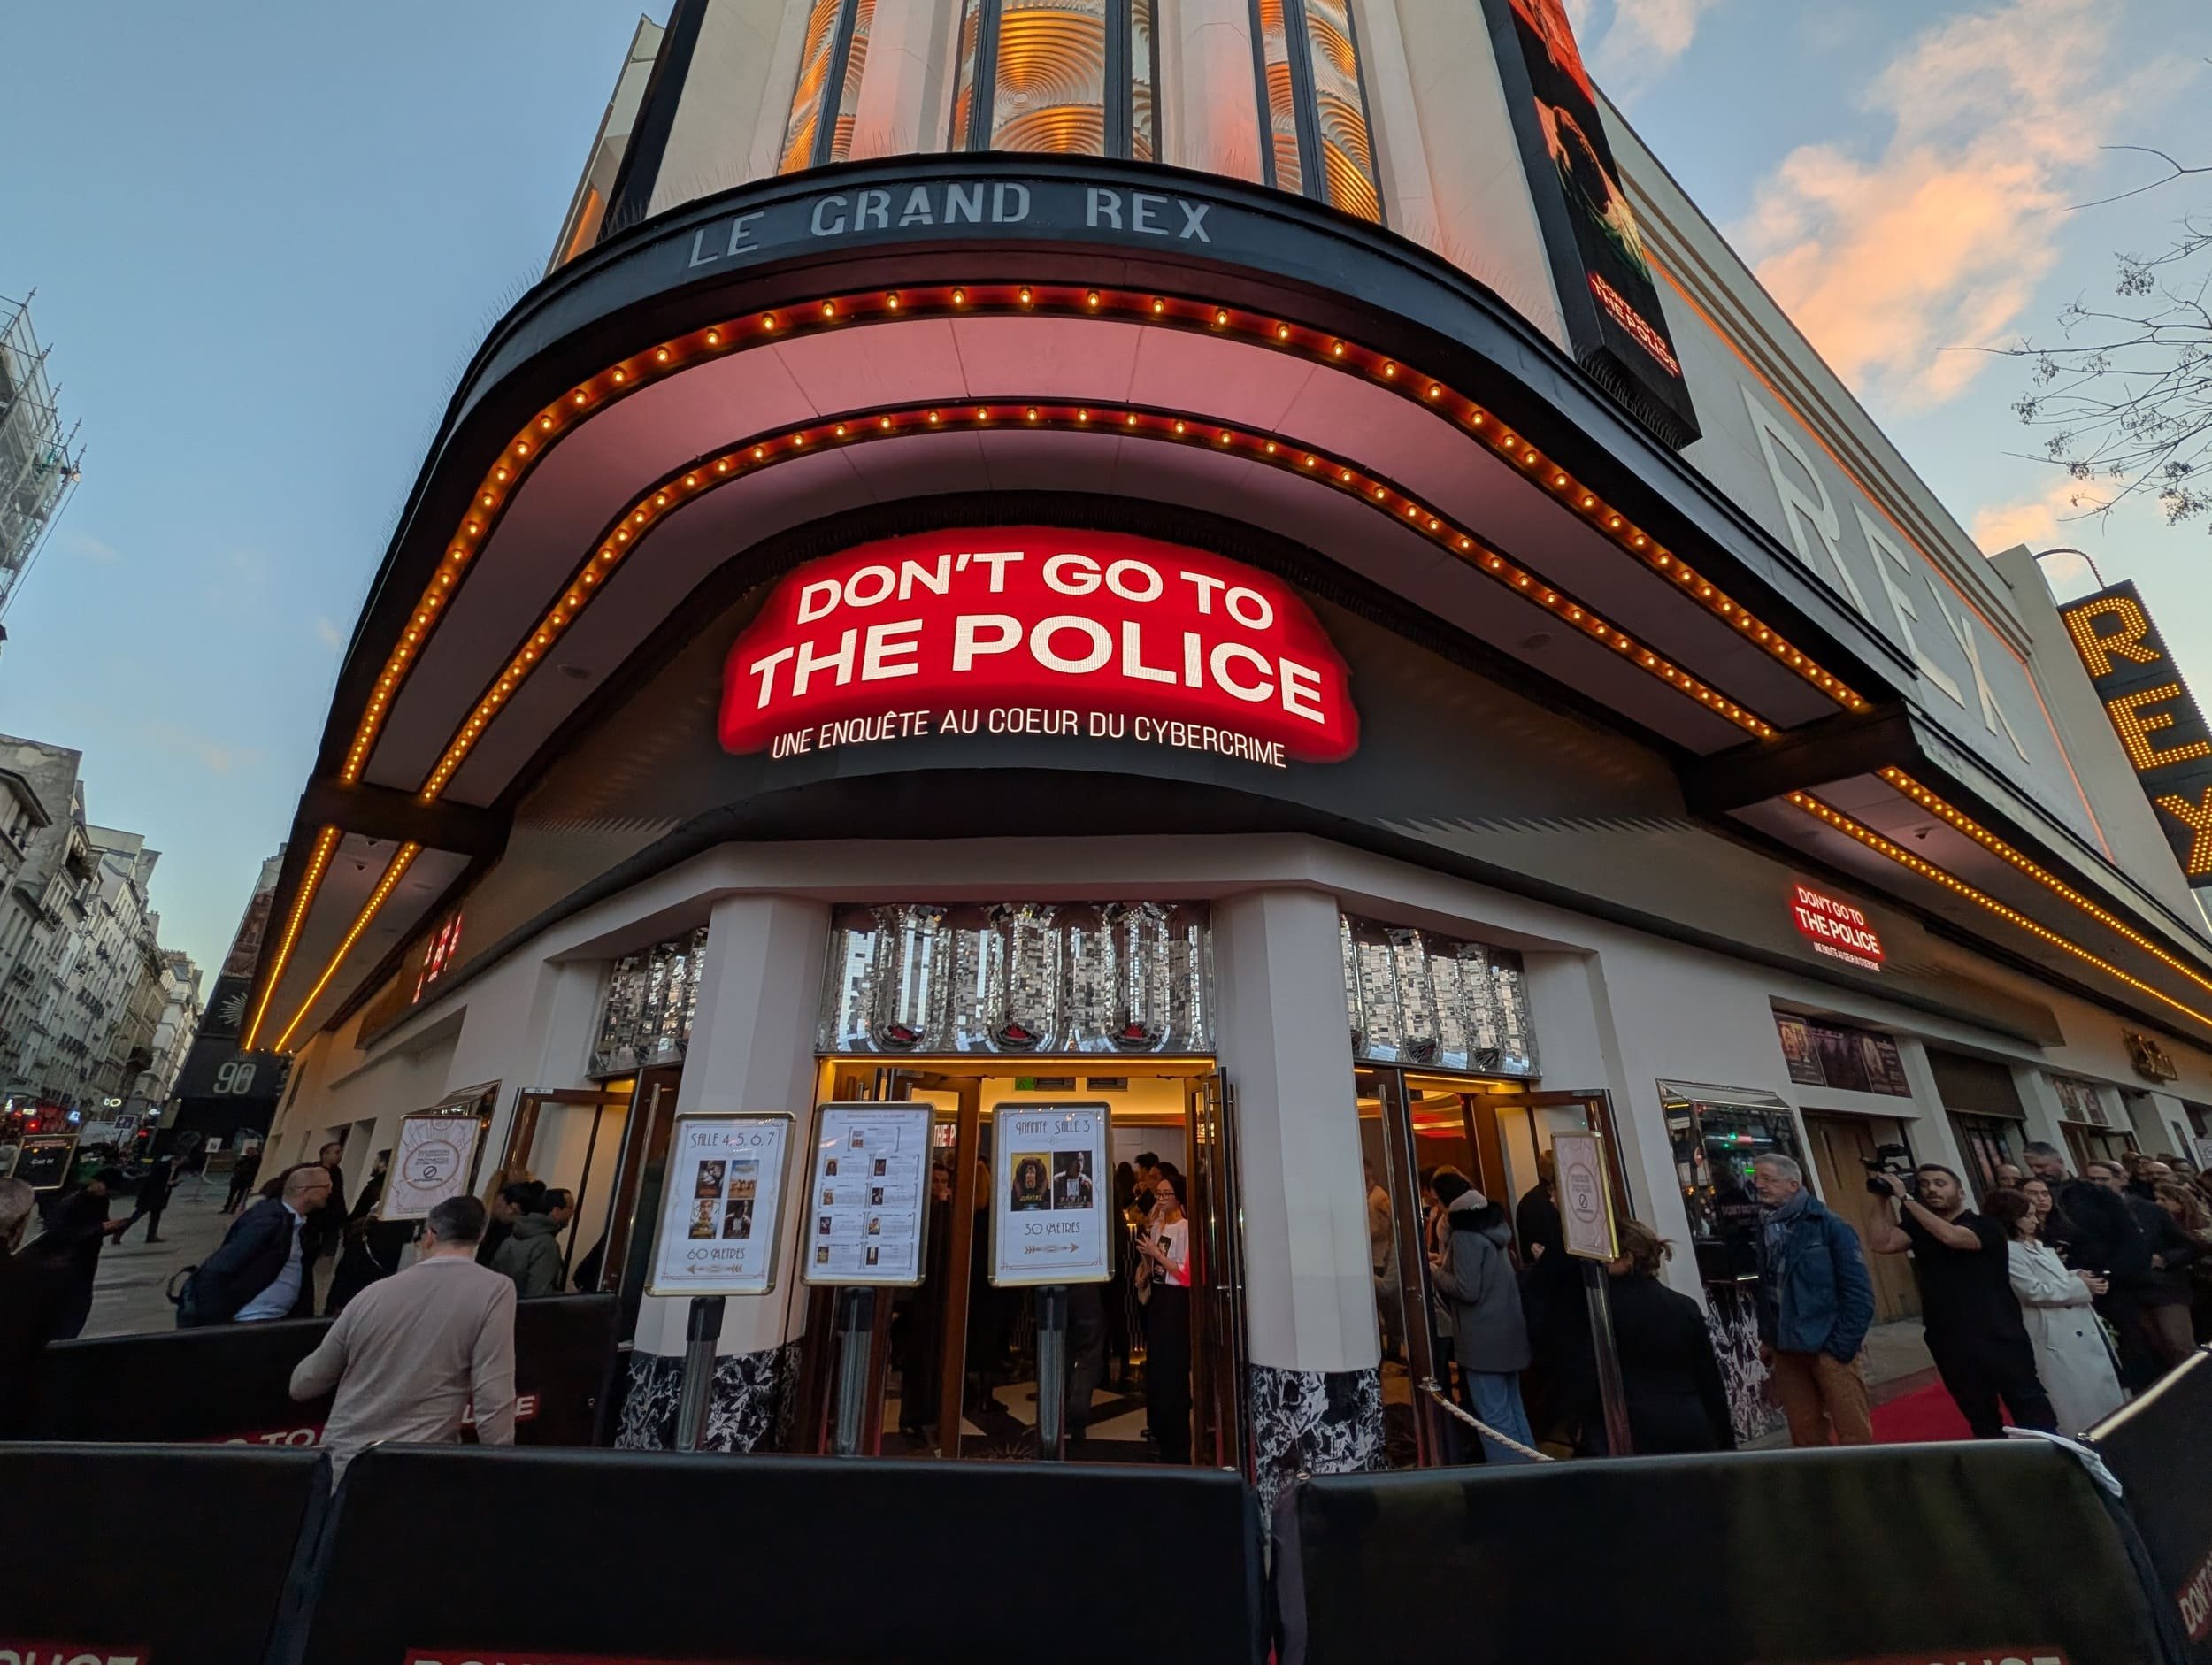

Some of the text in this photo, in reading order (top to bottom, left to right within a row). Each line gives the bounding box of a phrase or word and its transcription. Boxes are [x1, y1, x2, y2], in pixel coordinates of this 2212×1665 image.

[688, 182, 1212, 268] LE GRAND REX
[796, 550, 1274, 630] DON'T GO TO
[1739, 380, 2030, 764] REX
[749, 613, 1326, 725] THE POLICE
[772, 707, 1286, 769] UNE ENQUÊTE AU COEUR DU CYBERCRIME
[1795, 906, 1881, 955] THE POLICE
[1797, 886, 1864, 926] DON'T GO TO
[689, 1132, 718, 1148] SALLE
[767, 1132, 775, 1146] 7
[1054, 1120, 1079, 1135] SALLE
[1083, 1119, 1091, 1132] 3
[1024, 1223, 1043, 1236] 30
[687, 1248, 708, 1261] 60
